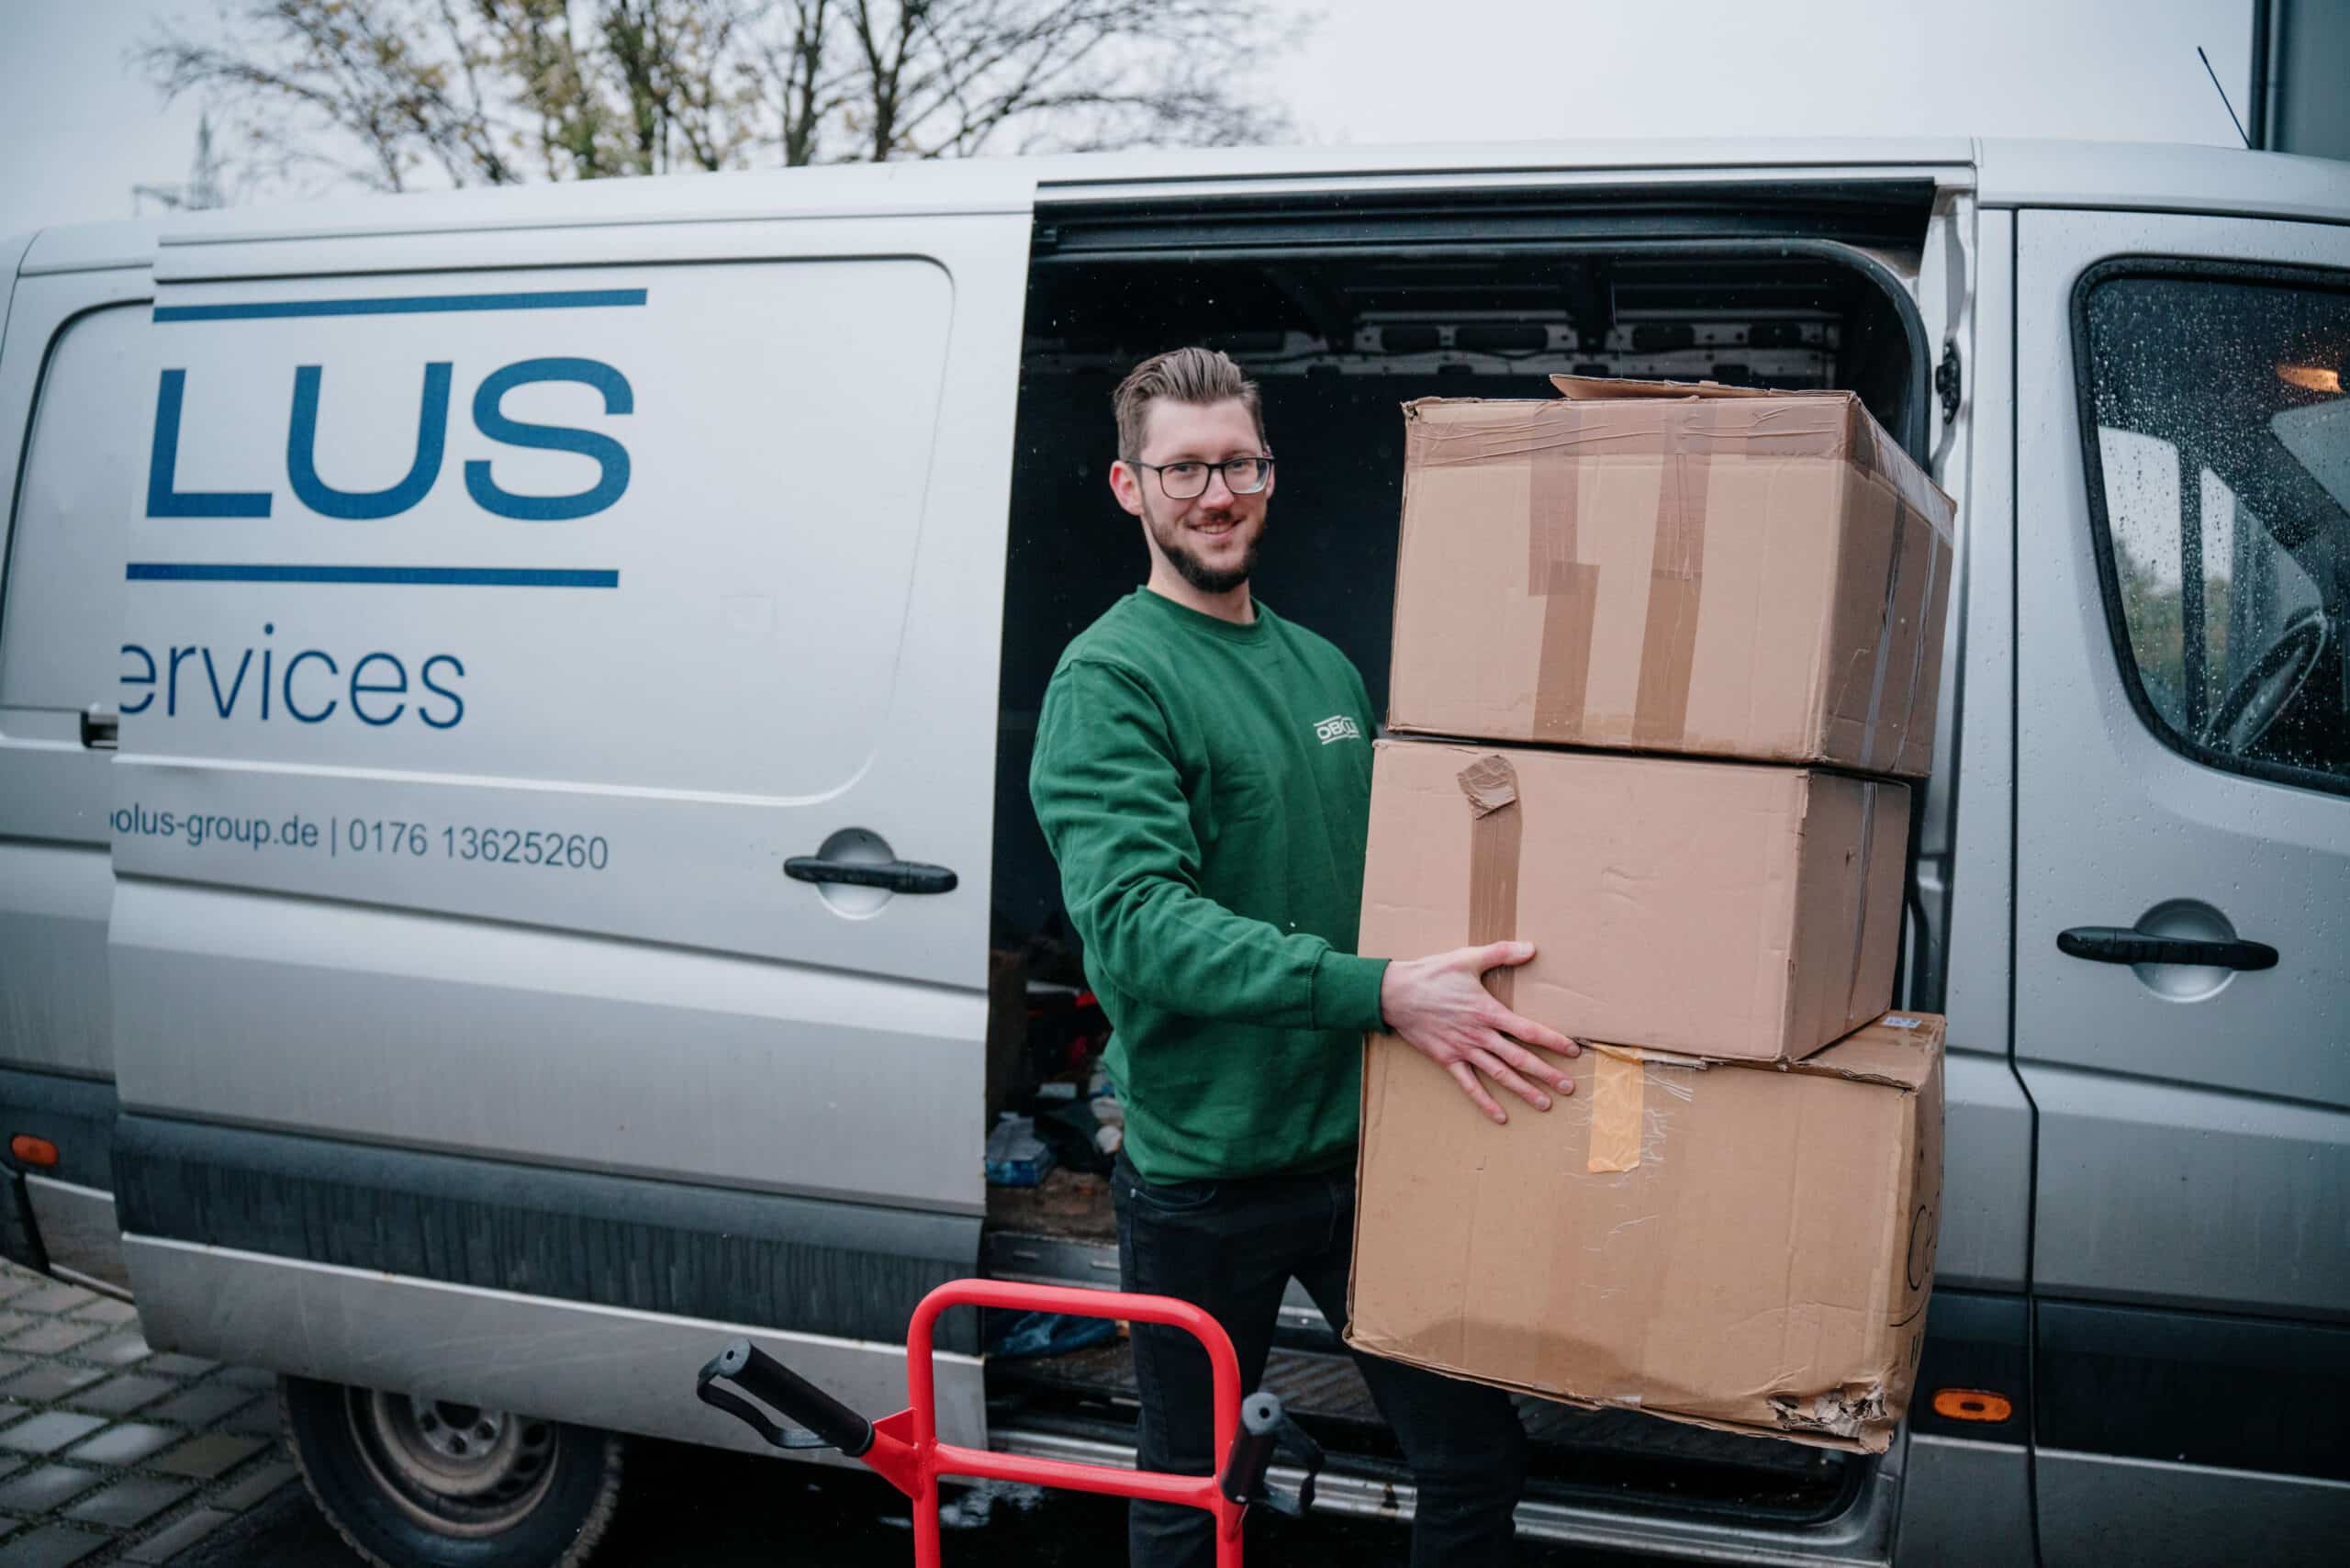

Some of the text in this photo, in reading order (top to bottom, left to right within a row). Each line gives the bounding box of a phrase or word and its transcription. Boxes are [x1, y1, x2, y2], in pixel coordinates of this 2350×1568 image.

[146, 356, 634, 521] LUS
[119, 622, 465, 729] ervices
[110, 802, 319, 850] olus-group.de
[348, 818, 428, 857] 0176
[442, 825, 609, 870] 13625260
